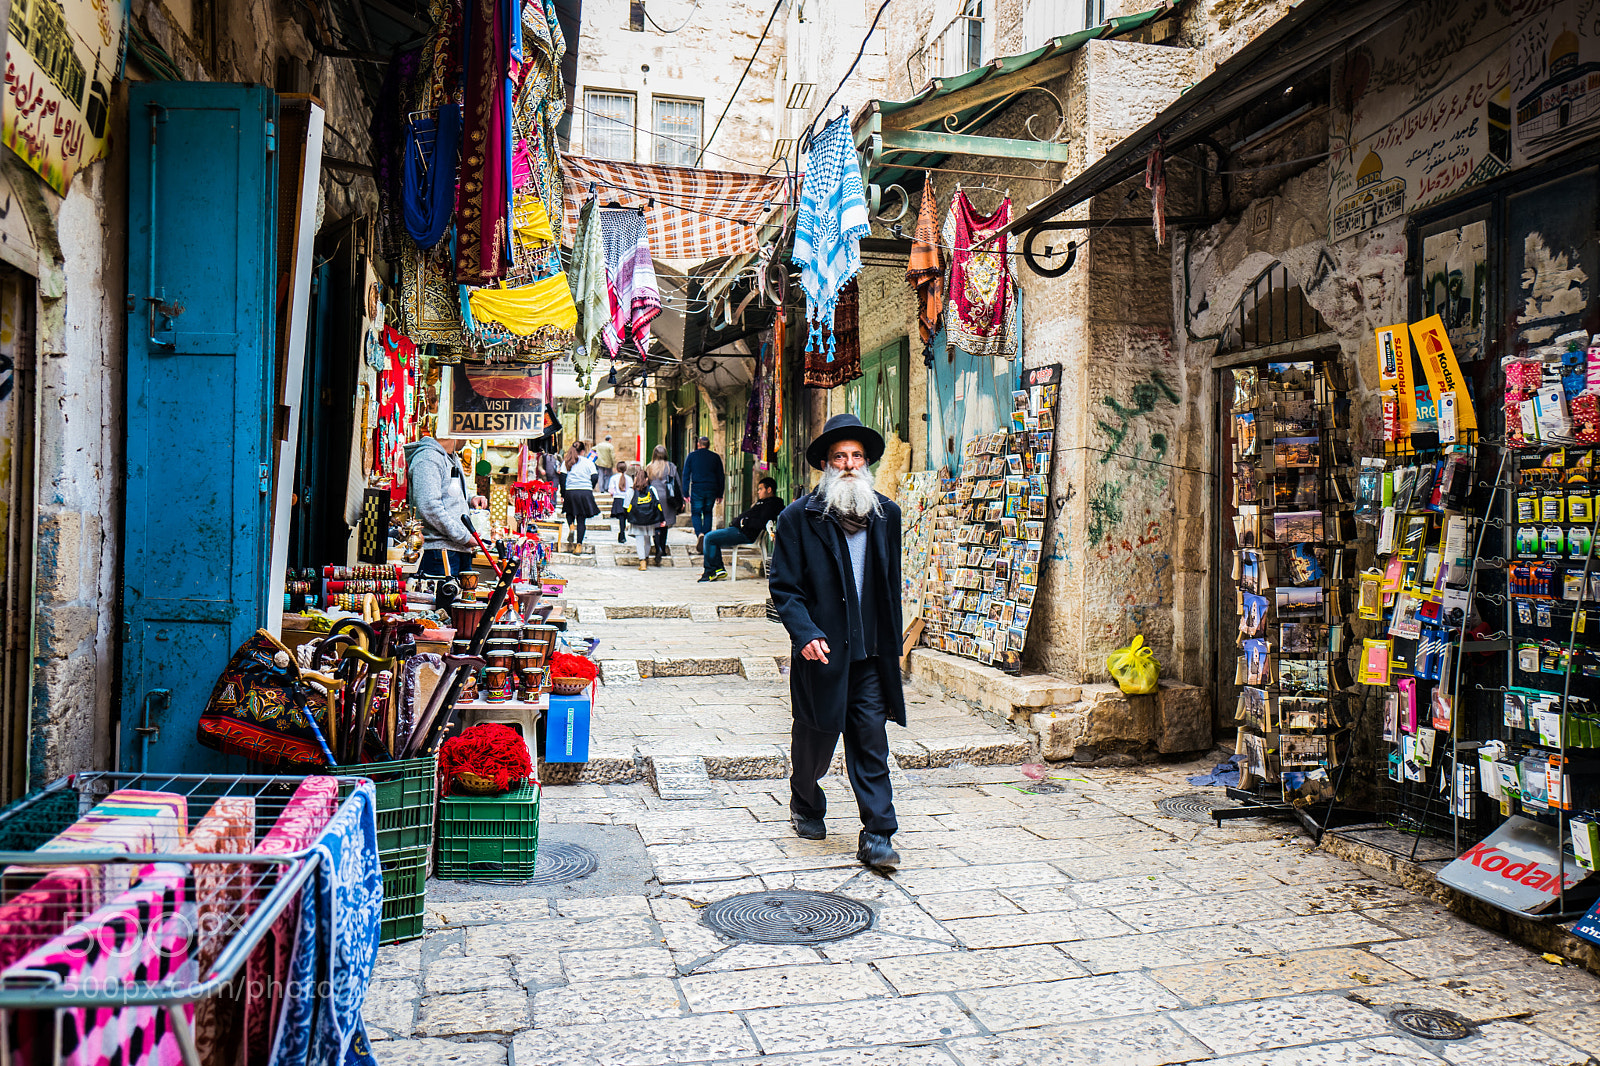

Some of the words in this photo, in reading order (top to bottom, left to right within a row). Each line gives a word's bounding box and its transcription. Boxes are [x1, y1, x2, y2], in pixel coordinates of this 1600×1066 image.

[1394, 337, 1407, 395] PRODUCTS
[1437, 352, 1456, 391] Kodak
[453, 413, 542, 431] PALESTINE
[485, 400, 511, 411] VISIT
[1383, 402, 1394, 441] PINK
[1457, 842, 1575, 897] Kodak
